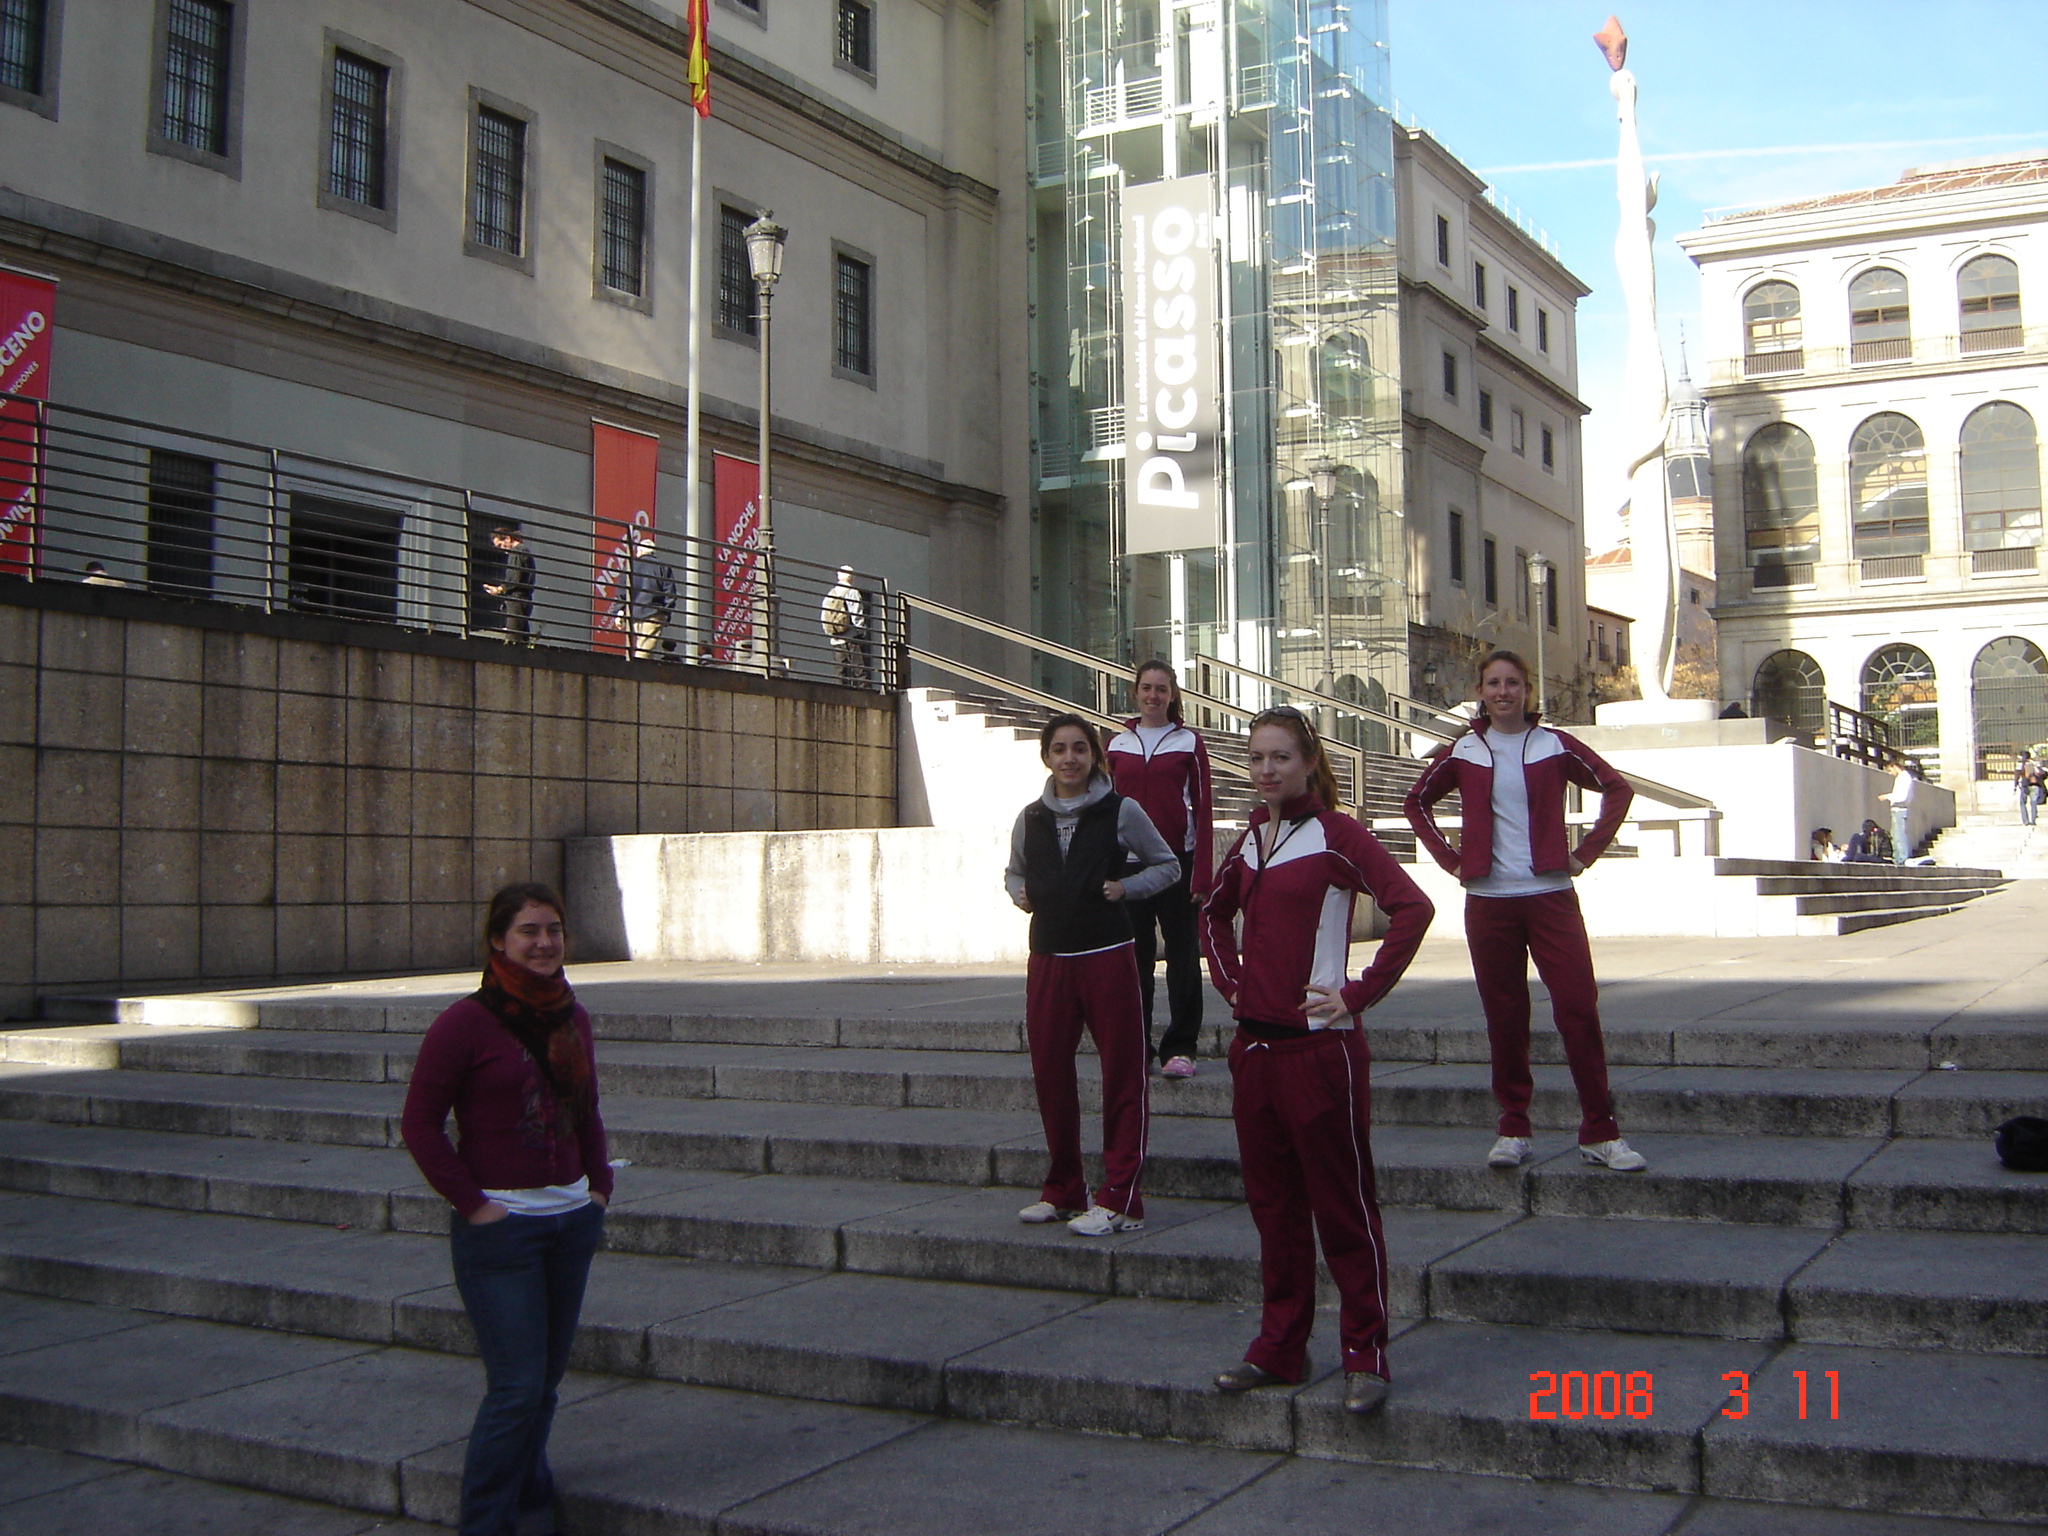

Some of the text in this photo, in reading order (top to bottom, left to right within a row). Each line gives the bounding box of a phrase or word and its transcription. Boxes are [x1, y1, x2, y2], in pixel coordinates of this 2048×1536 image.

[0, 310, 46, 377] CENO
[1136, 206, 1200, 509] Picasso
[727, 501, 757, 546] NOCHE
